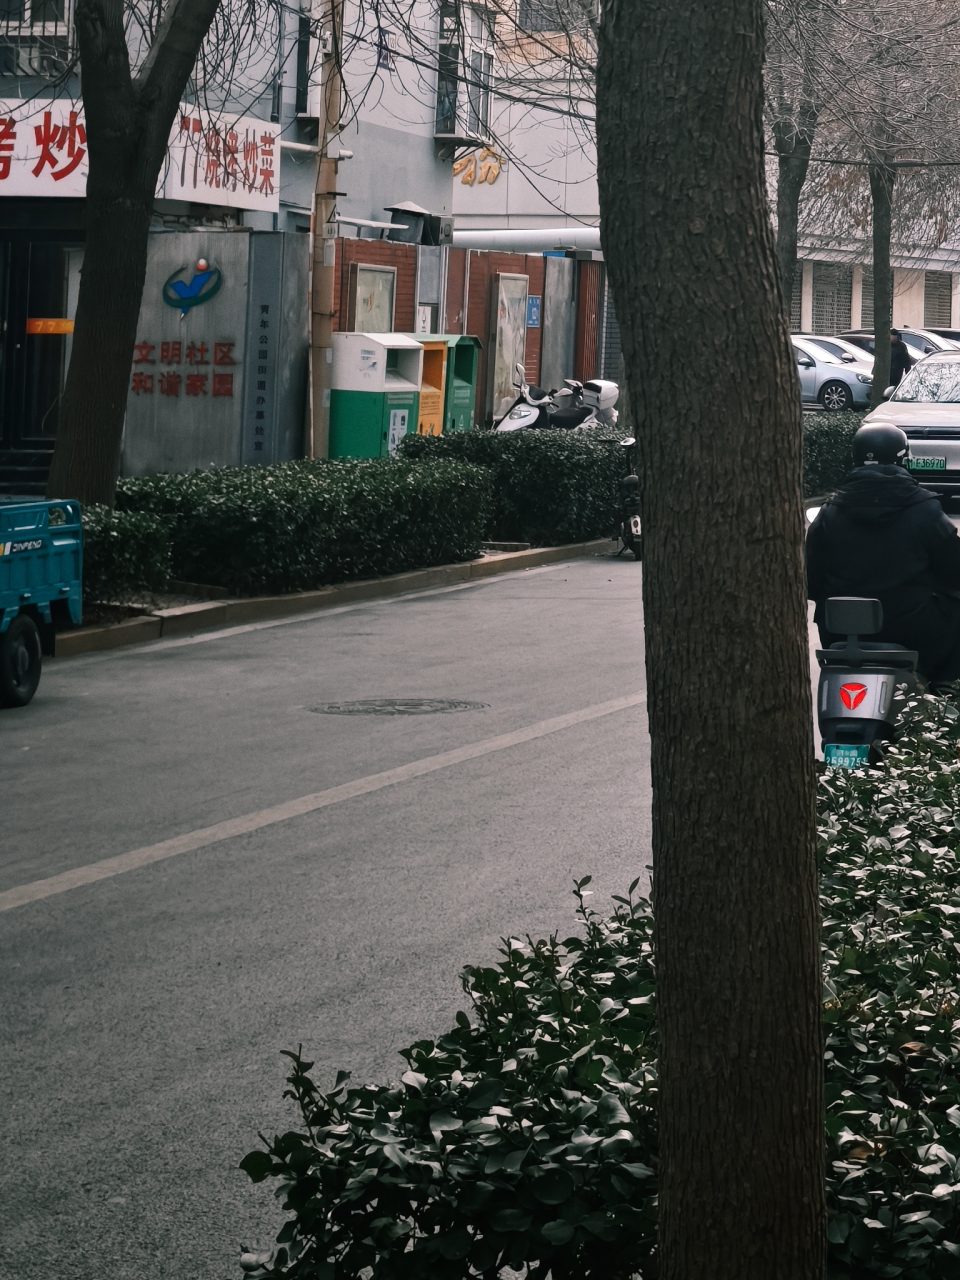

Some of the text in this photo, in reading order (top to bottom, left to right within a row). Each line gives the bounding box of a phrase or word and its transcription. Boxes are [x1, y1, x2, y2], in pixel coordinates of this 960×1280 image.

[133, 341, 237, 365] 文明社区
[131, 371, 233, 397] 和谐家园
